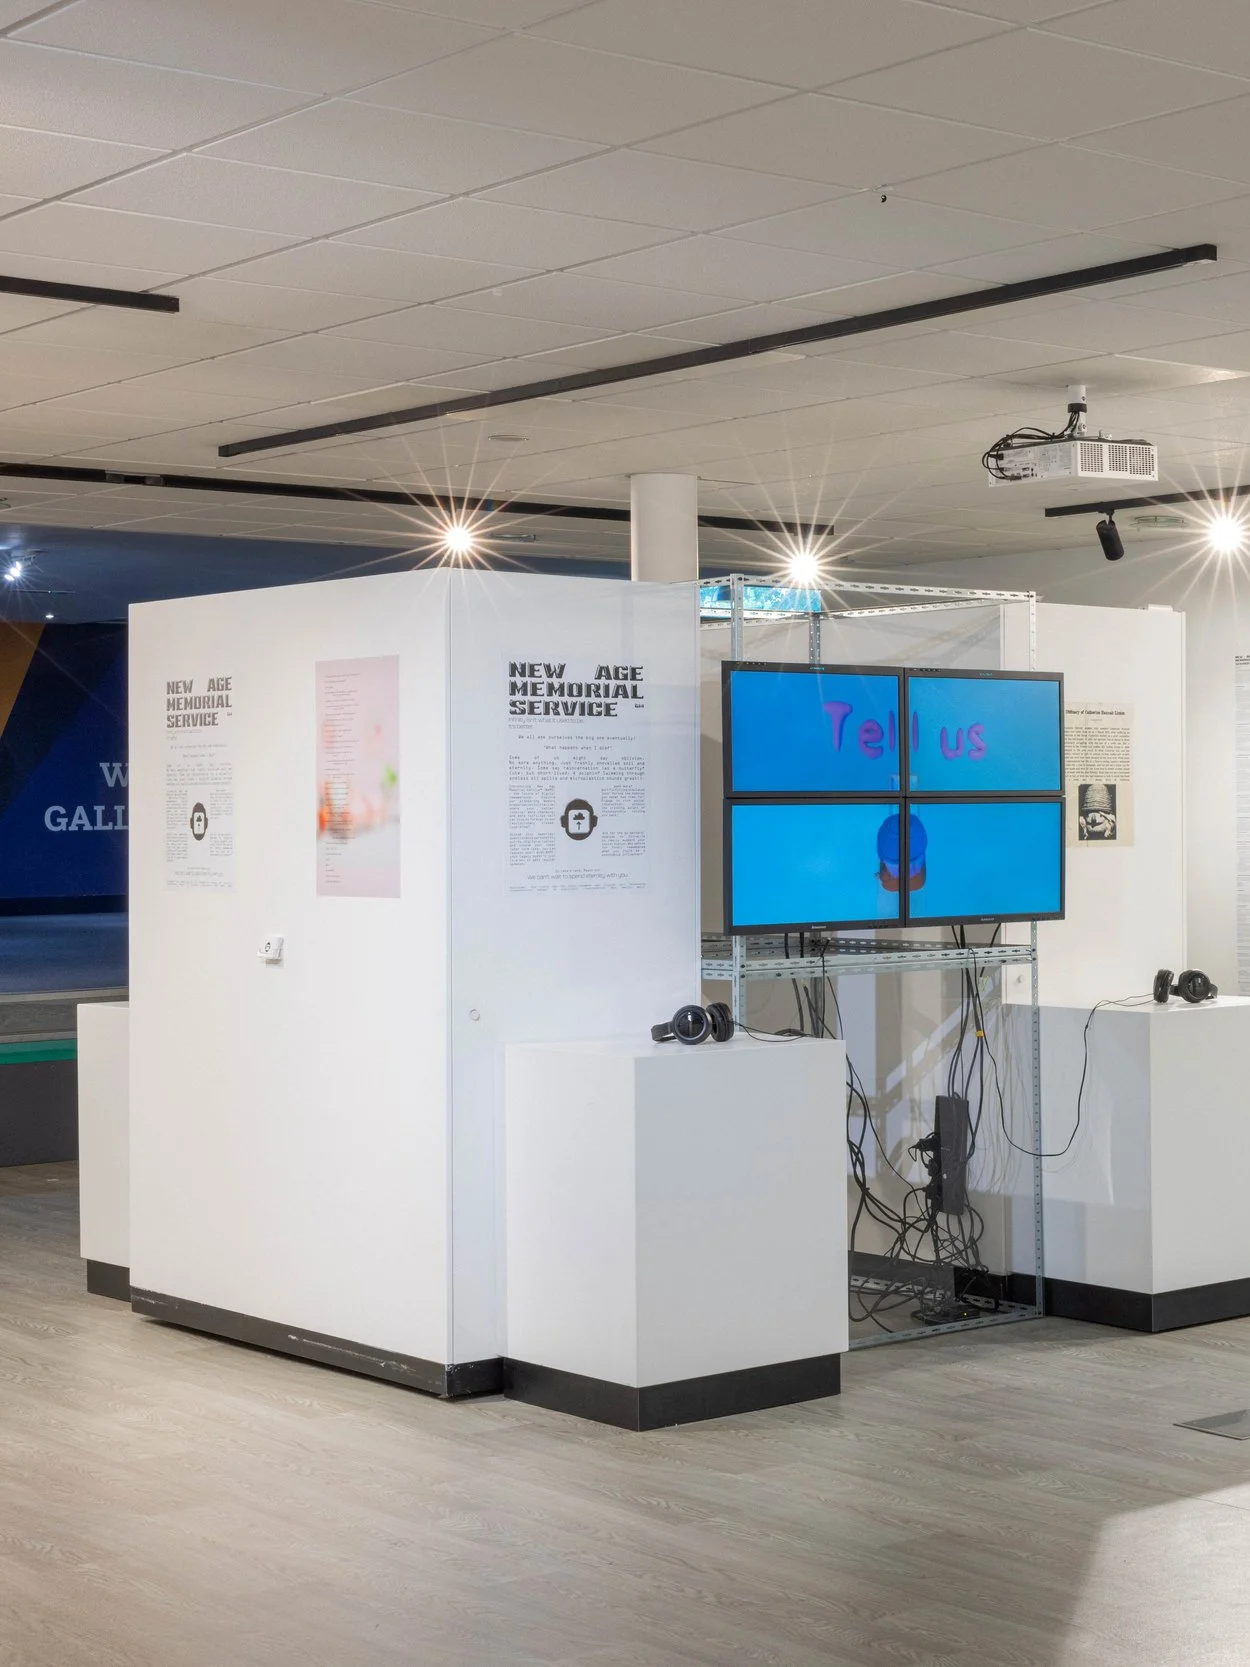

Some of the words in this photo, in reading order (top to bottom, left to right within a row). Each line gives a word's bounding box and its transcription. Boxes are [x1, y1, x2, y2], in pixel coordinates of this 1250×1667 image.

[508, 661, 566, 679] NEW
[594, 664, 644, 681] AGE
[166, 678, 193, 695] NEW
[207, 676, 232, 692] AGE
[508, 679, 644, 699] MEMORIAL
[166, 694, 232, 711] MEMORIAL
[508, 699, 618, 717] SERVICE
[166, 711, 219, 728] SERVICE
[823, 701, 921, 759] Tell
[940, 722, 988, 761] us
